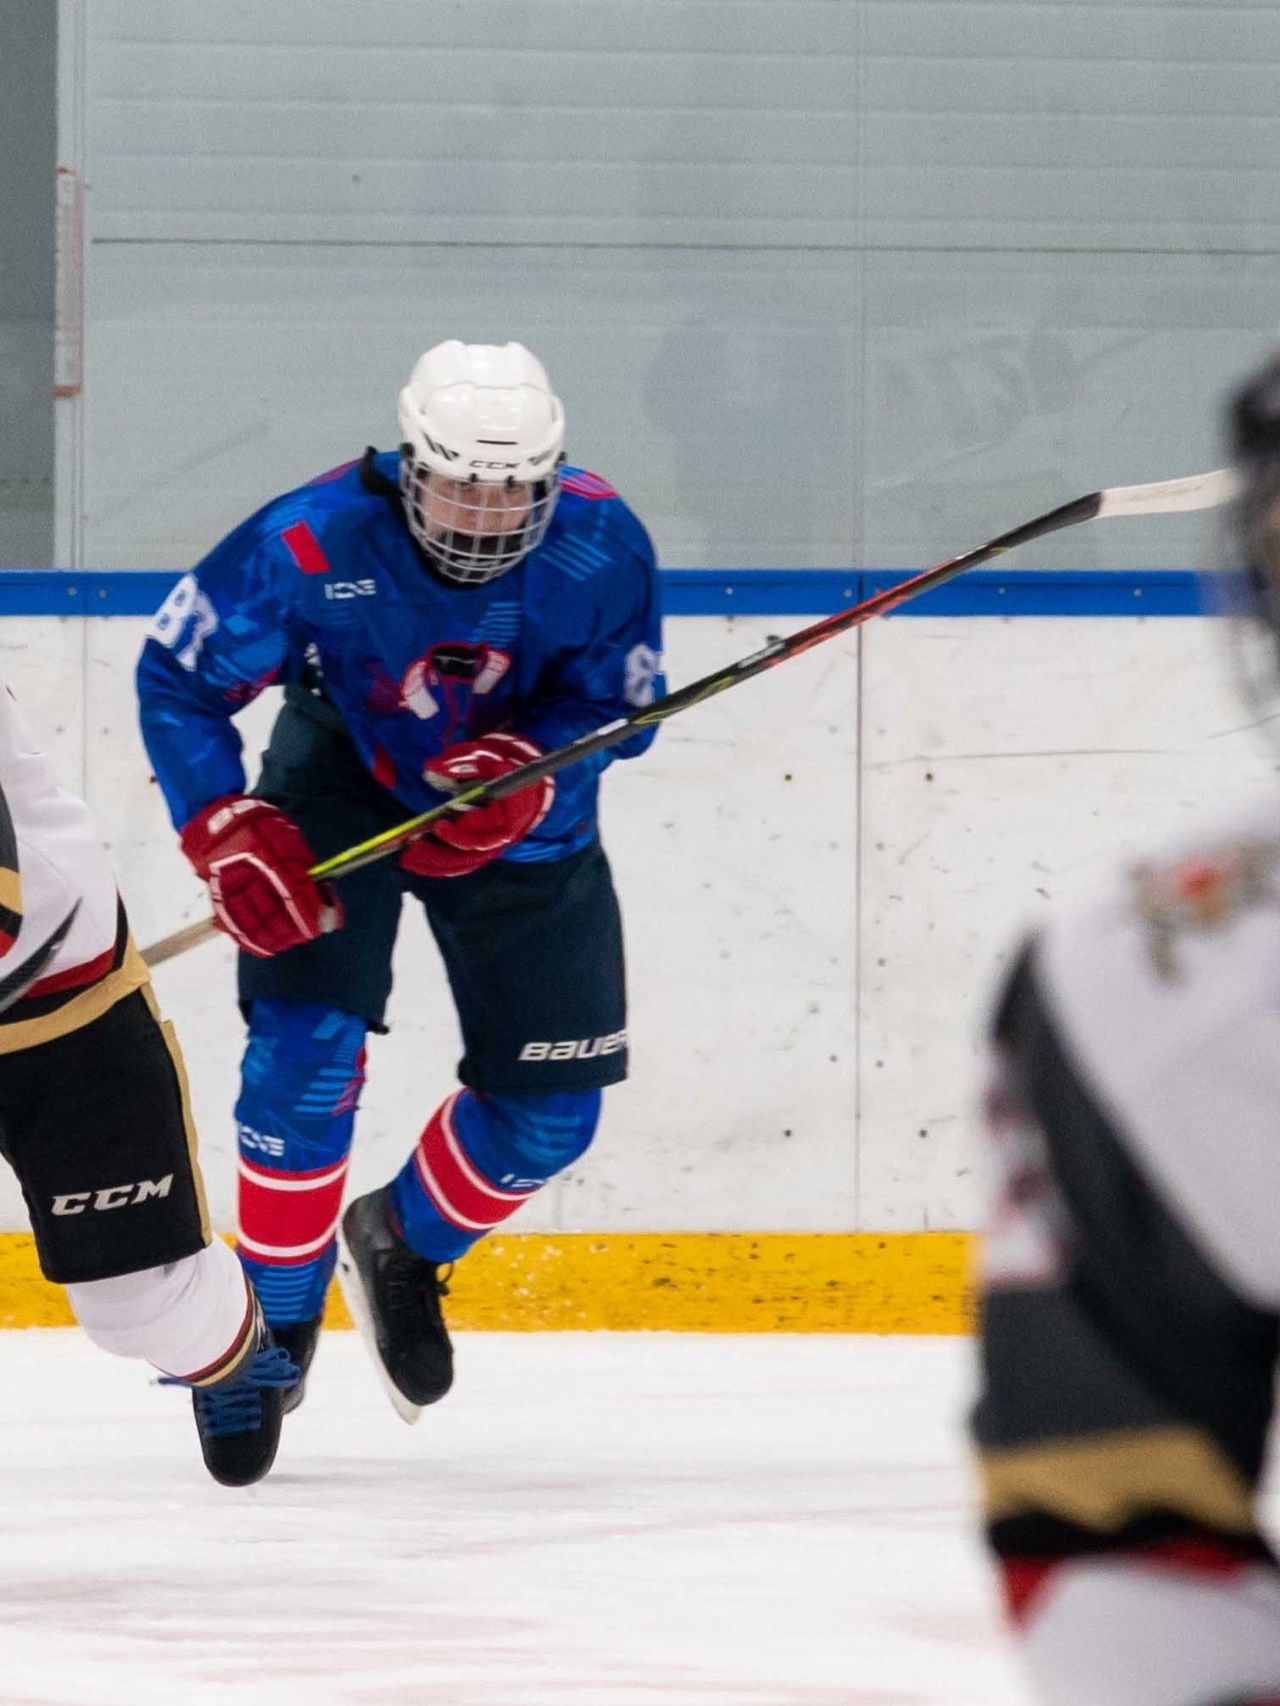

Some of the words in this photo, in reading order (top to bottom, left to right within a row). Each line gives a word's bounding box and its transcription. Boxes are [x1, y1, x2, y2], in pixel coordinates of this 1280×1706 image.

[146, 571, 219, 672] 87
[624, 644, 664, 706] 8
[51, 1173, 174, 1216] CCM
